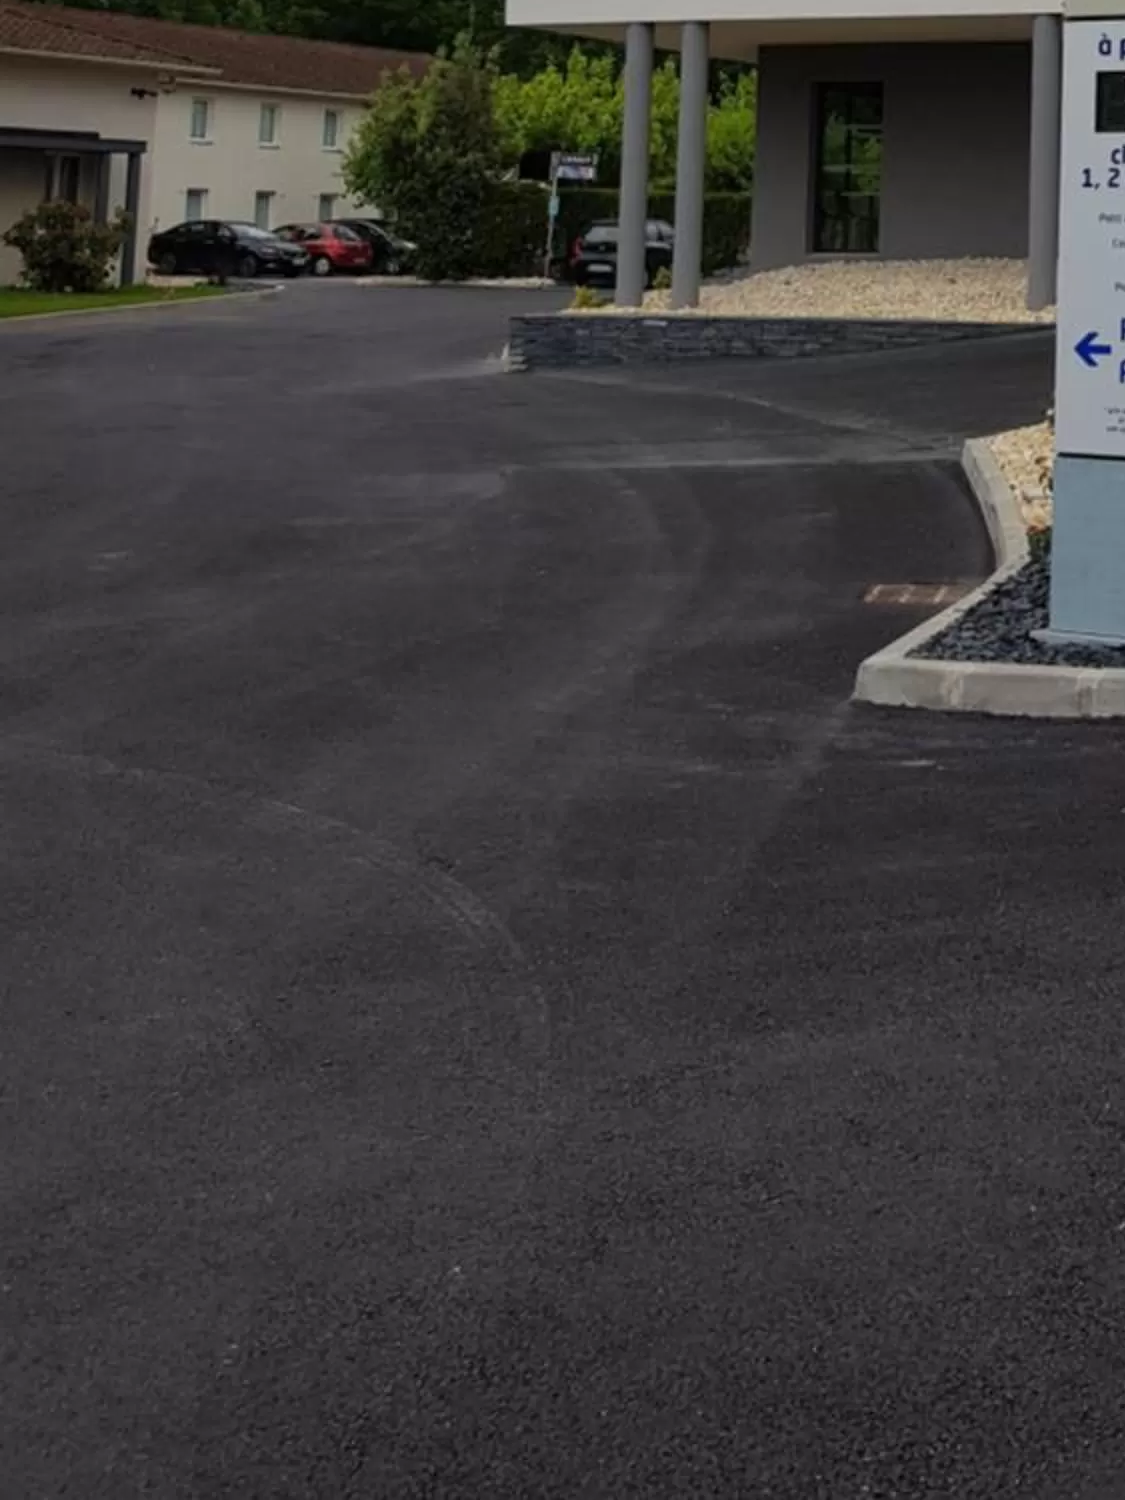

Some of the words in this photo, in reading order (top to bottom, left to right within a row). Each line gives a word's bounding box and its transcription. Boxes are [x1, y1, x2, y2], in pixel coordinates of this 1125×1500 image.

[1097, 32, 1112, 56] à
[1081, 168, 1100, 190] 1,
[1107, 168, 1121, 189] 2
